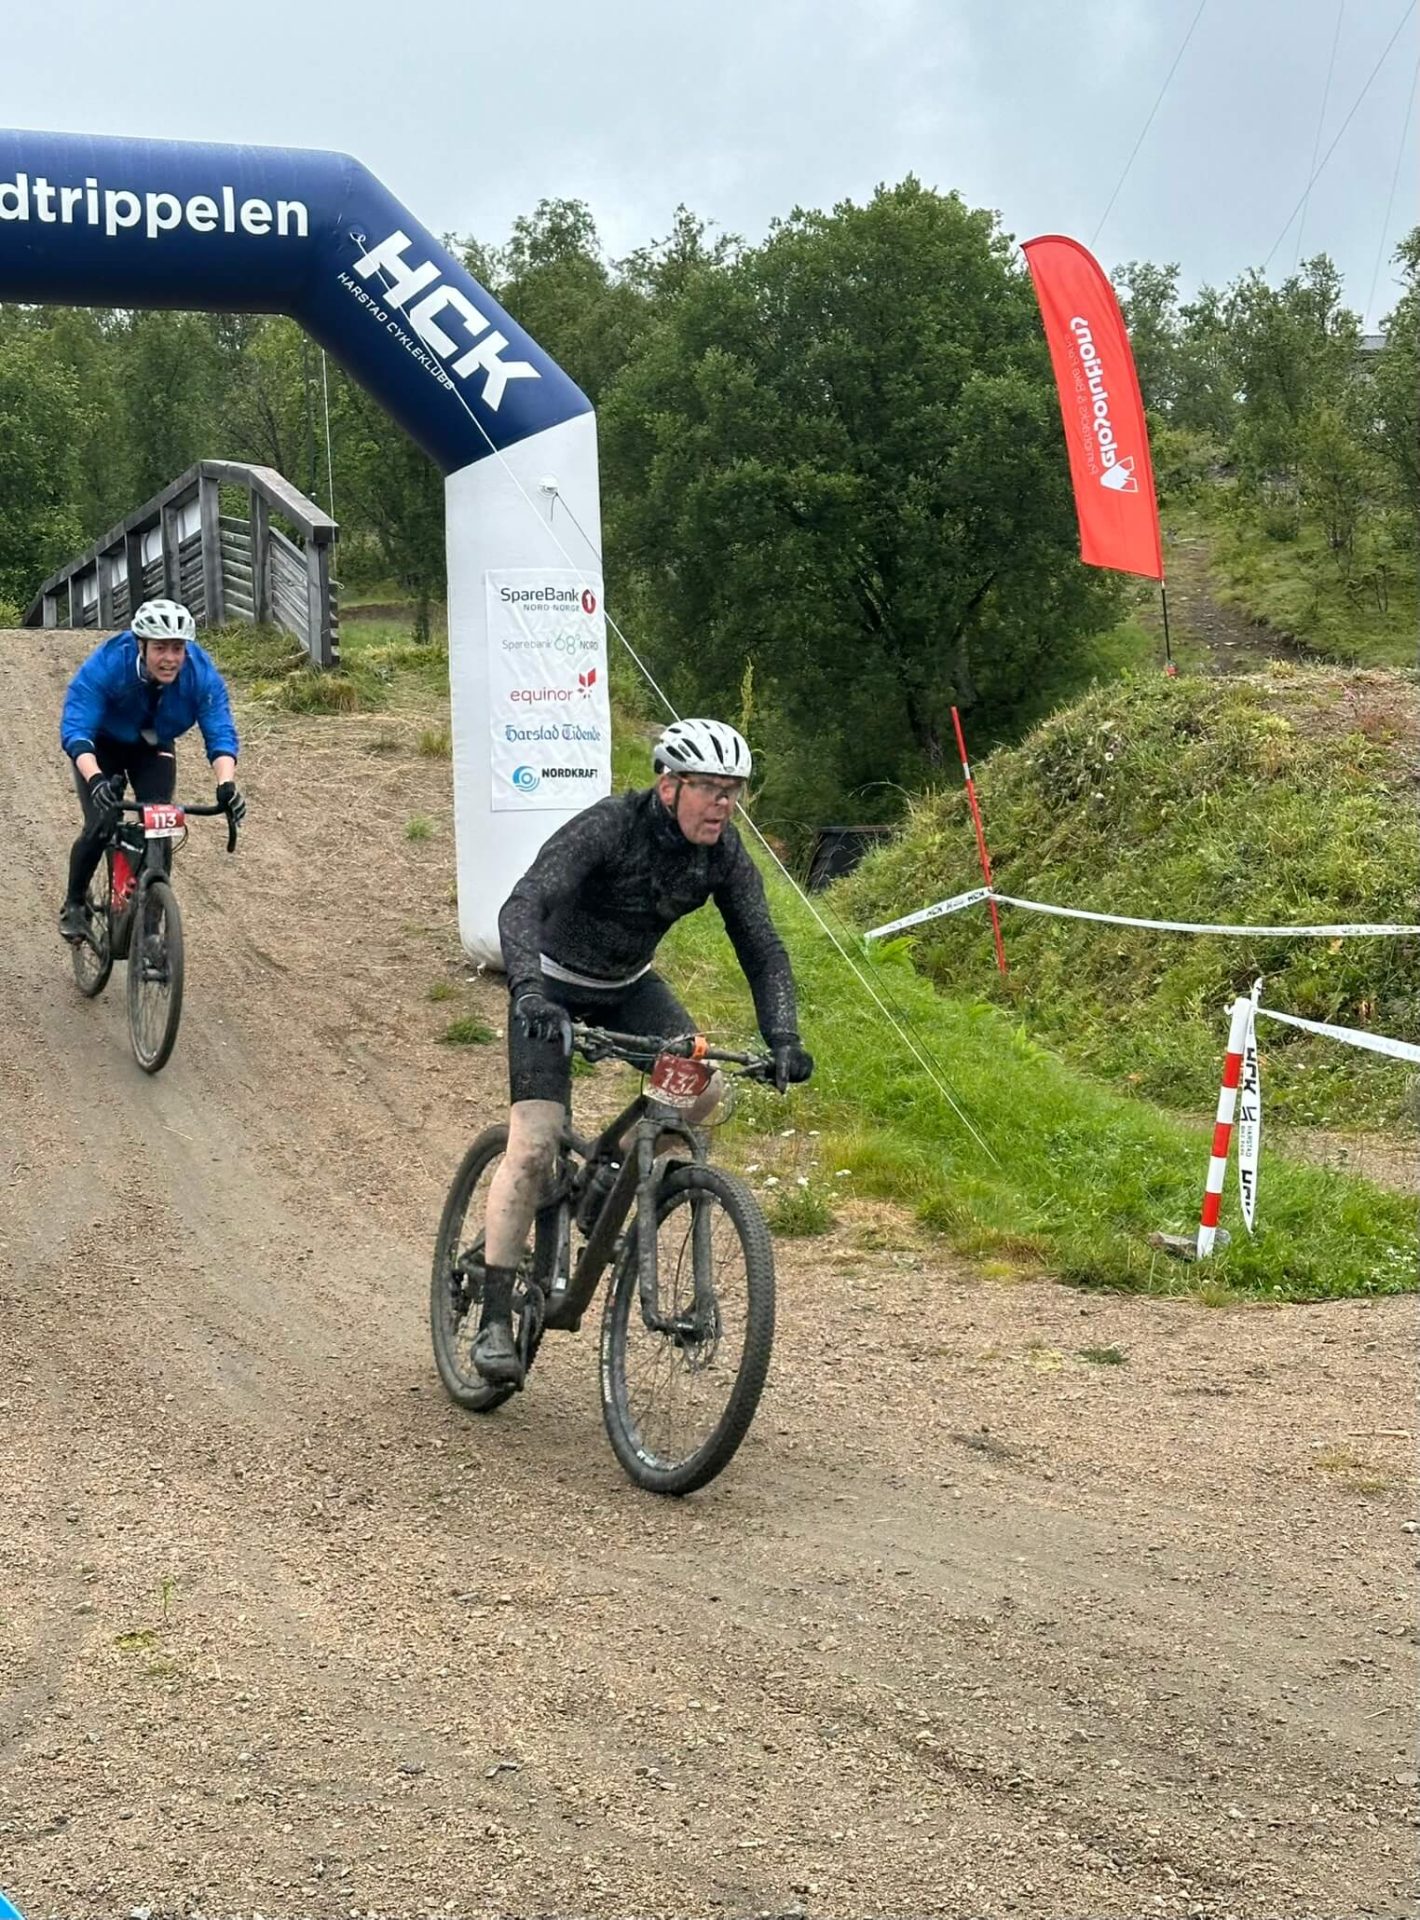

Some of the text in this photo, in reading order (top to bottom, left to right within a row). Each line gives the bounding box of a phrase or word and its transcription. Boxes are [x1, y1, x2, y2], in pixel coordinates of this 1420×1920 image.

[0, 172, 309, 239] dtrippelen
[353, 230, 542, 412] HCK
[337, 272, 453, 391] HARSTAD CYKLEKLUBB
[500, 587, 579, 603] SpareBank
[502, 640, 551, 651] Sparebank
[510, 687, 573, 704] equinor
[505, 724, 600, 743] Harstad Tidende
[541, 768, 598, 778] NORDKRAFT
[152, 813, 177, 828] 113
[662, 1068, 698, 1094] 132
